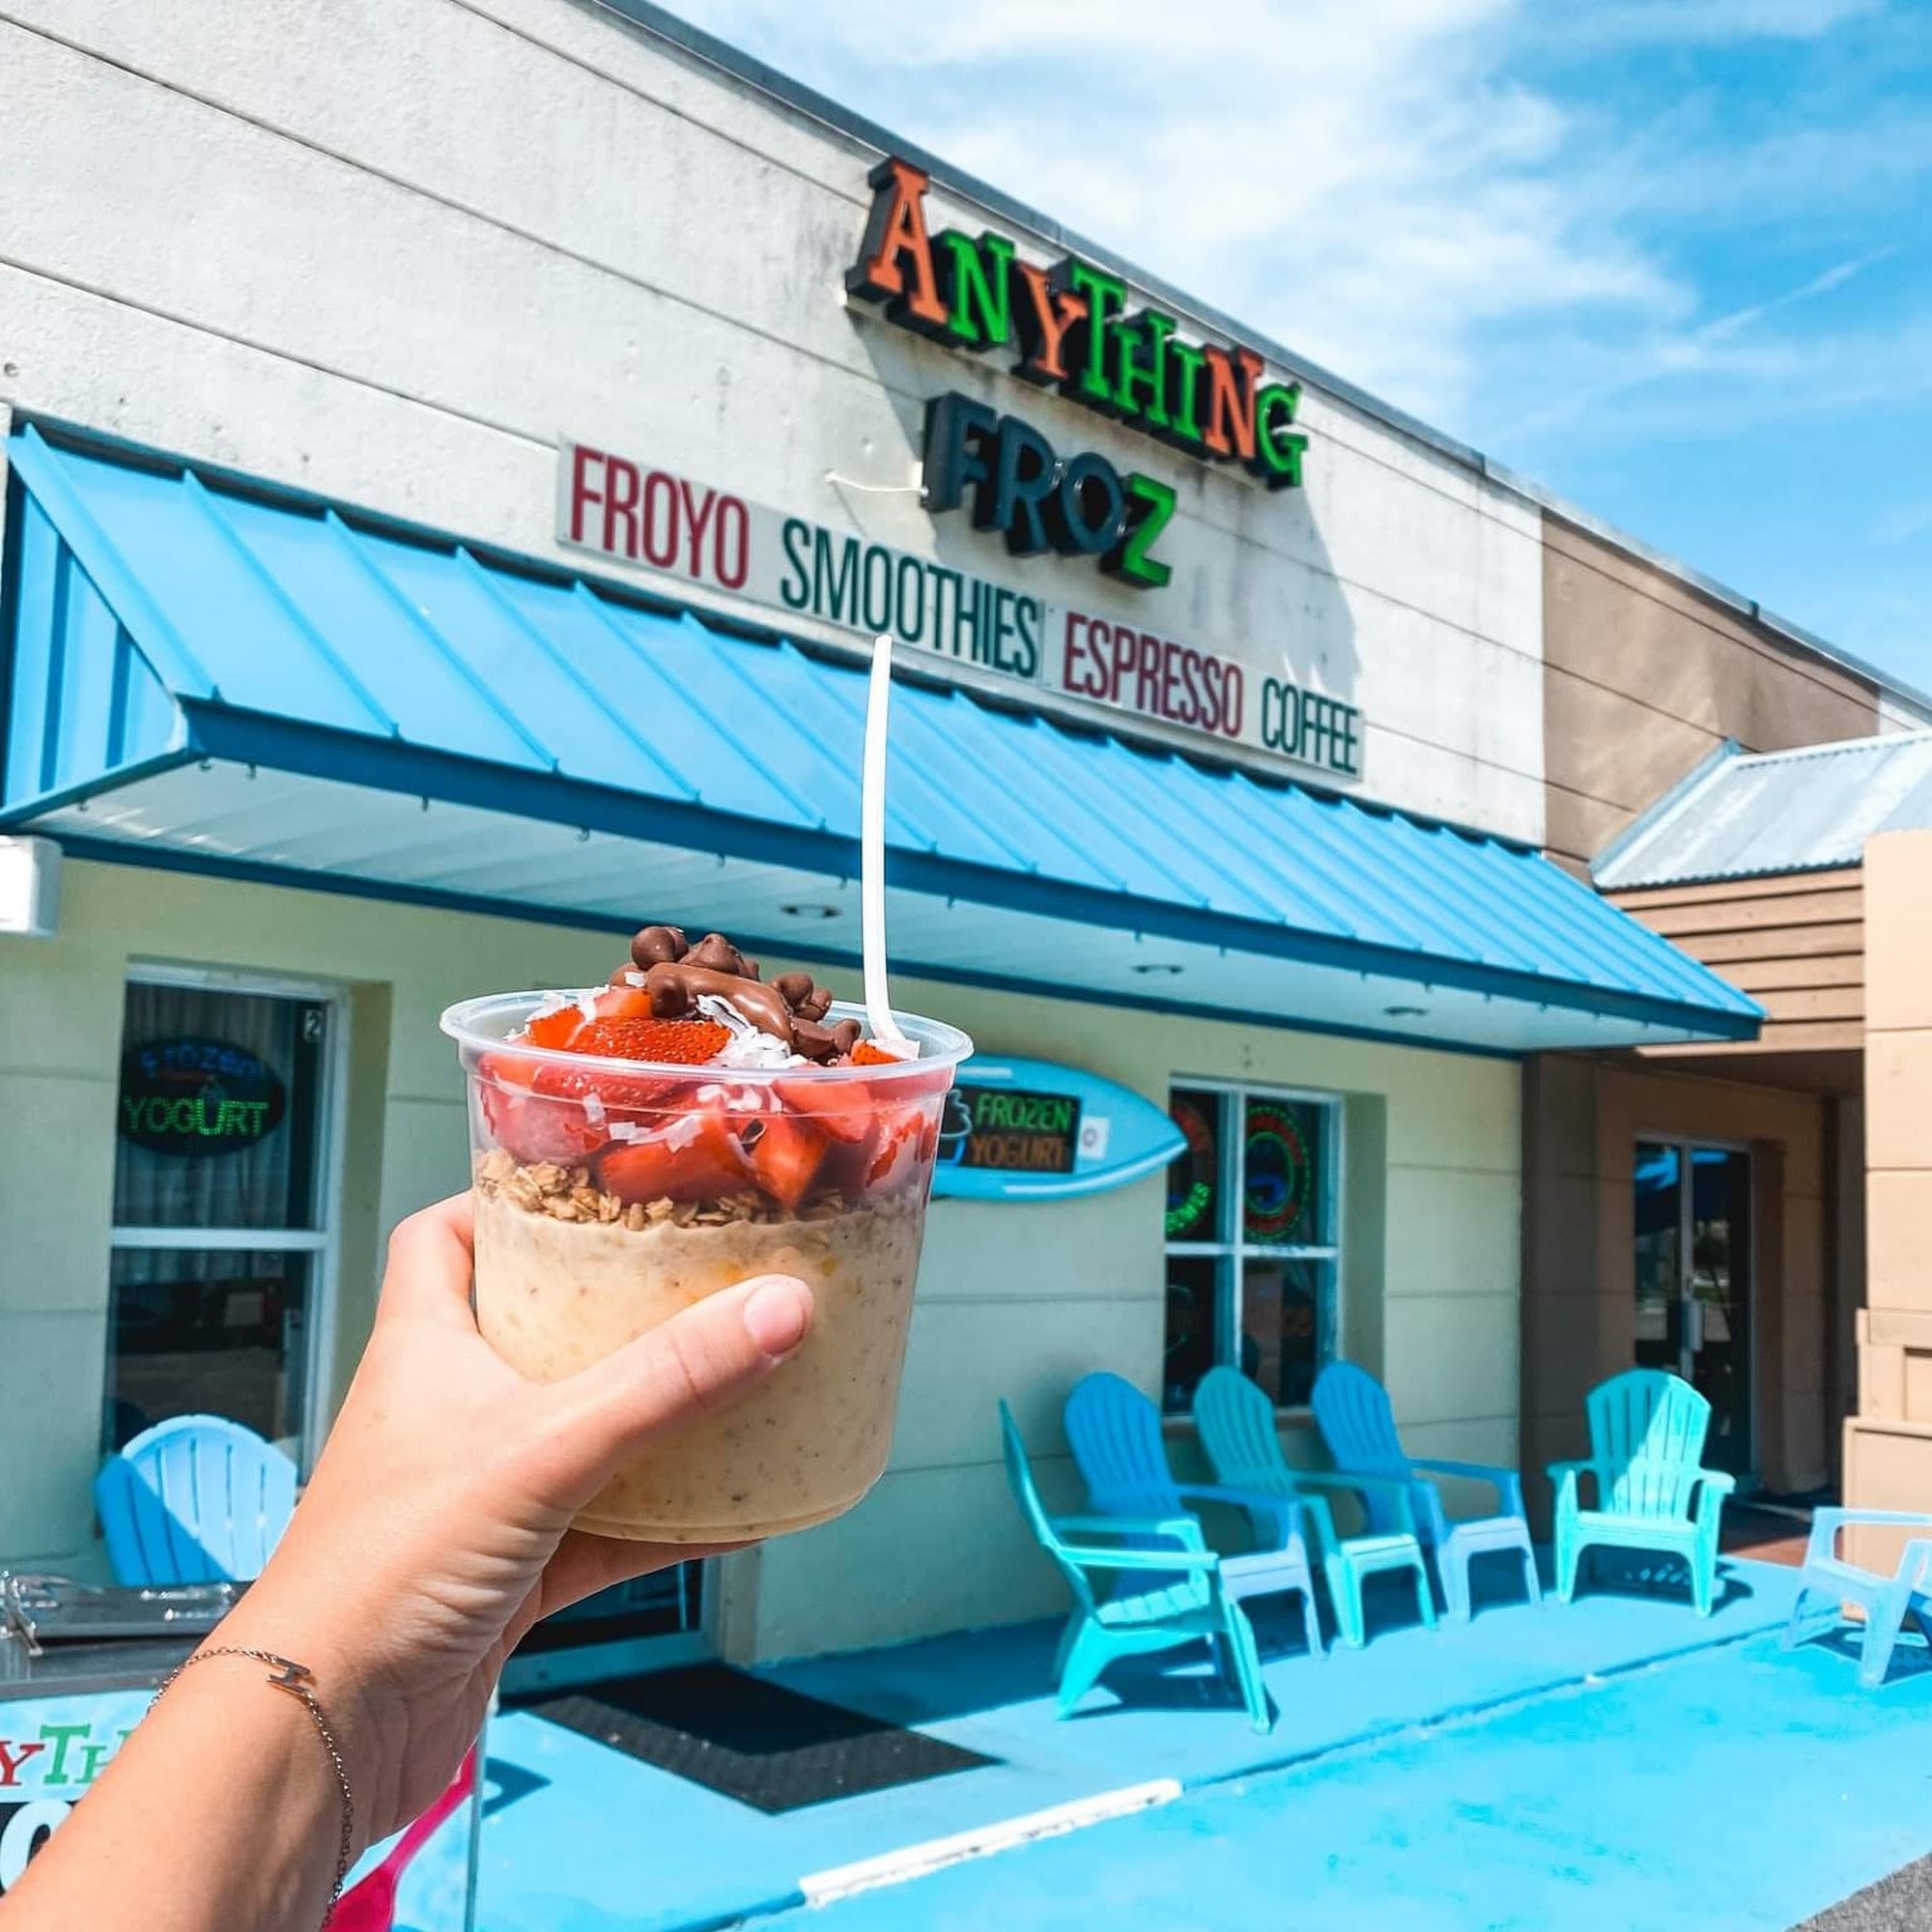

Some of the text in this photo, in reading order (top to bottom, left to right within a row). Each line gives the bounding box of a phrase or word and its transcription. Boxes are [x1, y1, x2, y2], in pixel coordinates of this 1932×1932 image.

[852, 156, 1308, 488] ANYTHING
[927, 391, 1177, 587] FROZ
[570, 443, 1359, 776] FROYO SMOOTHIES ESPRESSO COFFEE
[123, 1094, 270, 1137] YOGURT
[968, 1132, 1065, 1168] YOGURT
[974, 1092, 1072, 1132] FROZEN
